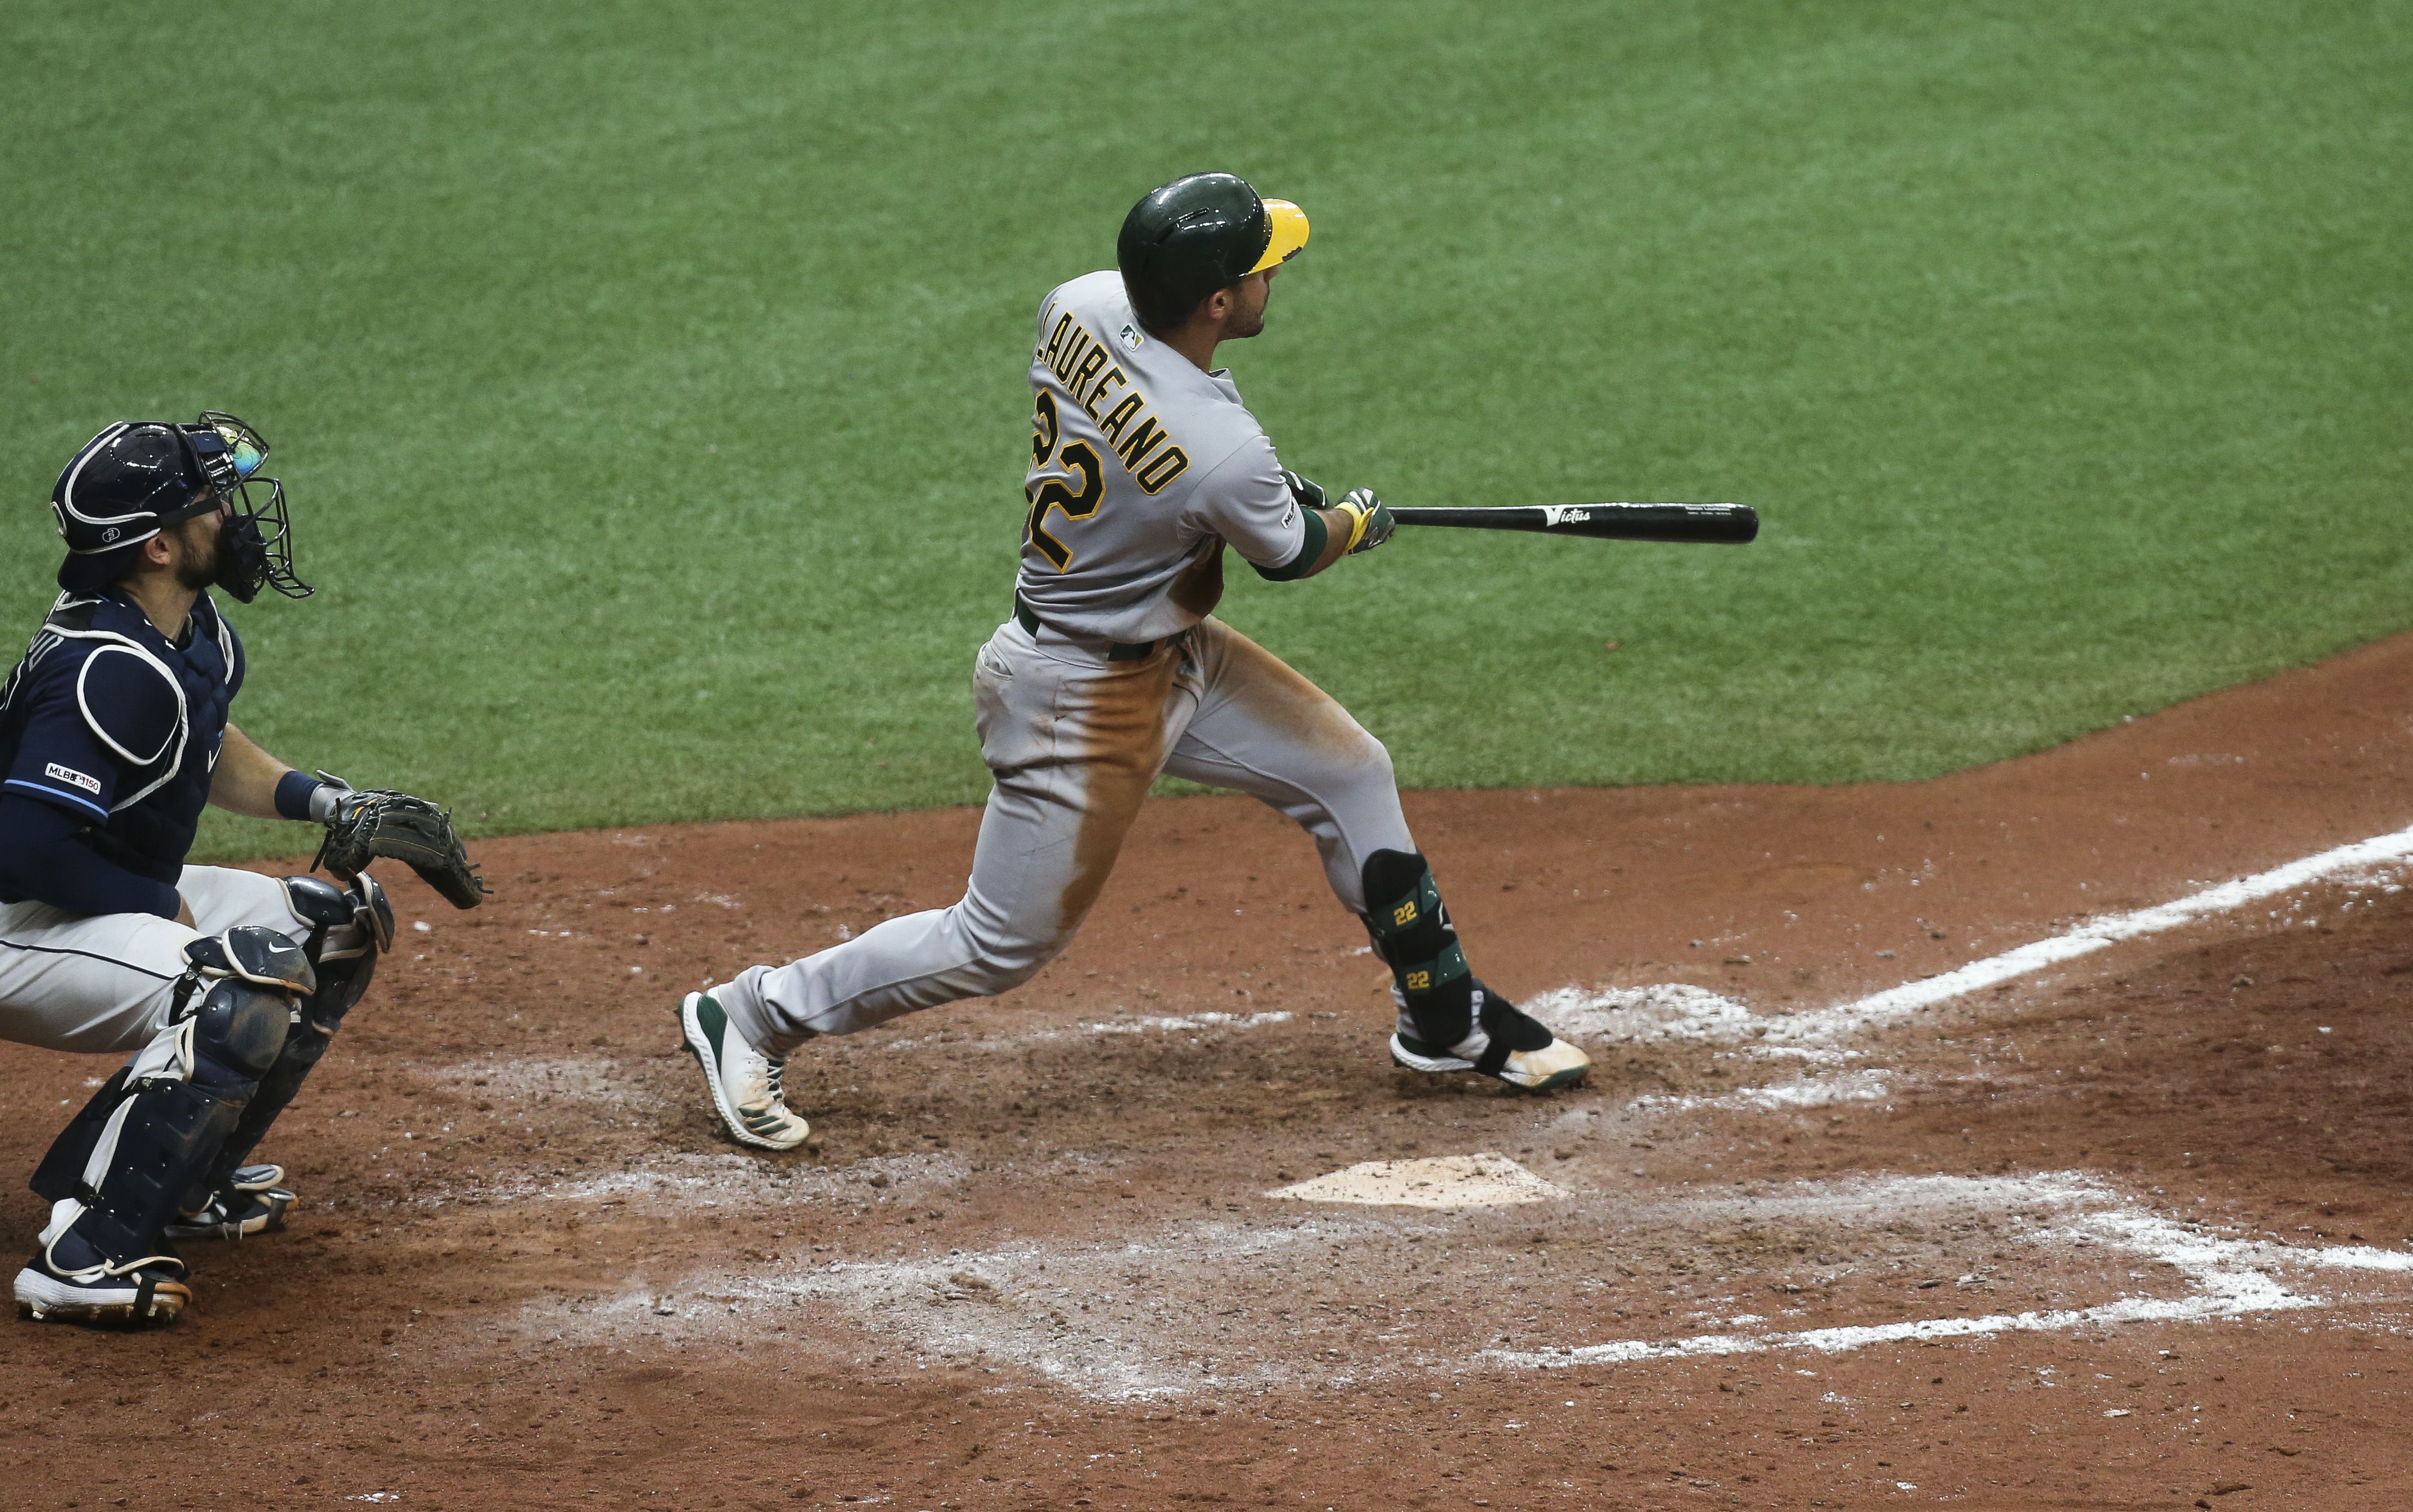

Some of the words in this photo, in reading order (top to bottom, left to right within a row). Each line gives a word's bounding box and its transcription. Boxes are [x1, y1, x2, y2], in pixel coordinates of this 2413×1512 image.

[1036, 300, 1190, 495] LAUREANO
[1025, 387, 1106, 574] 22
[1543, 507, 1590, 527] Victus
[48, 766, 71, 780] MLB
[86, 778, 99, 790] 150
[1393, 900, 1417, 926] 22
[1406, 970, 1430, 989] 22
